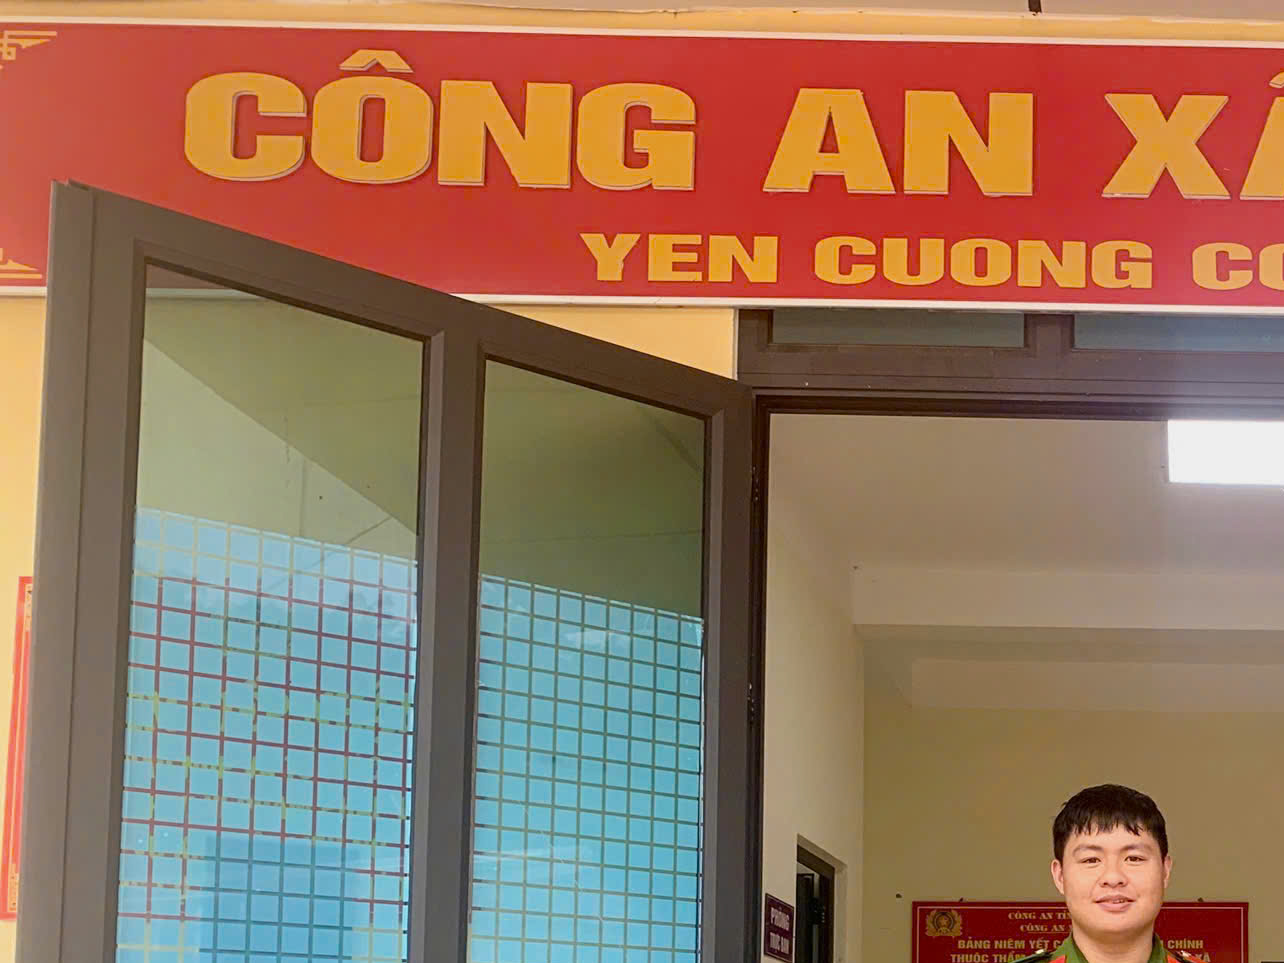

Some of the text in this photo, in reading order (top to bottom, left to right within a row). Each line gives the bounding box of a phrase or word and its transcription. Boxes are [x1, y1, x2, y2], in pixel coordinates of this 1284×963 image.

[184, 49, 697, 191] CÔNG
[764, 88, 1033, 197] AN
[581, 233, 778, 284] YEN
[814, 236, 1153, 291] CUONG
[1007, 910, 1036, 920] CÔNG
[1039, 912, 1055, 920] AN
[1020, 923, 1048, 932] CÔNG
[1051, 924, 1065, 932] AN
[957, 936, 991, 950] BẢNG
[994, 938, 1025, 949] NIÊM
[1028, 937, 1050, 950] YẾT
[1167, 938, 1204, 949] CHÍNH
